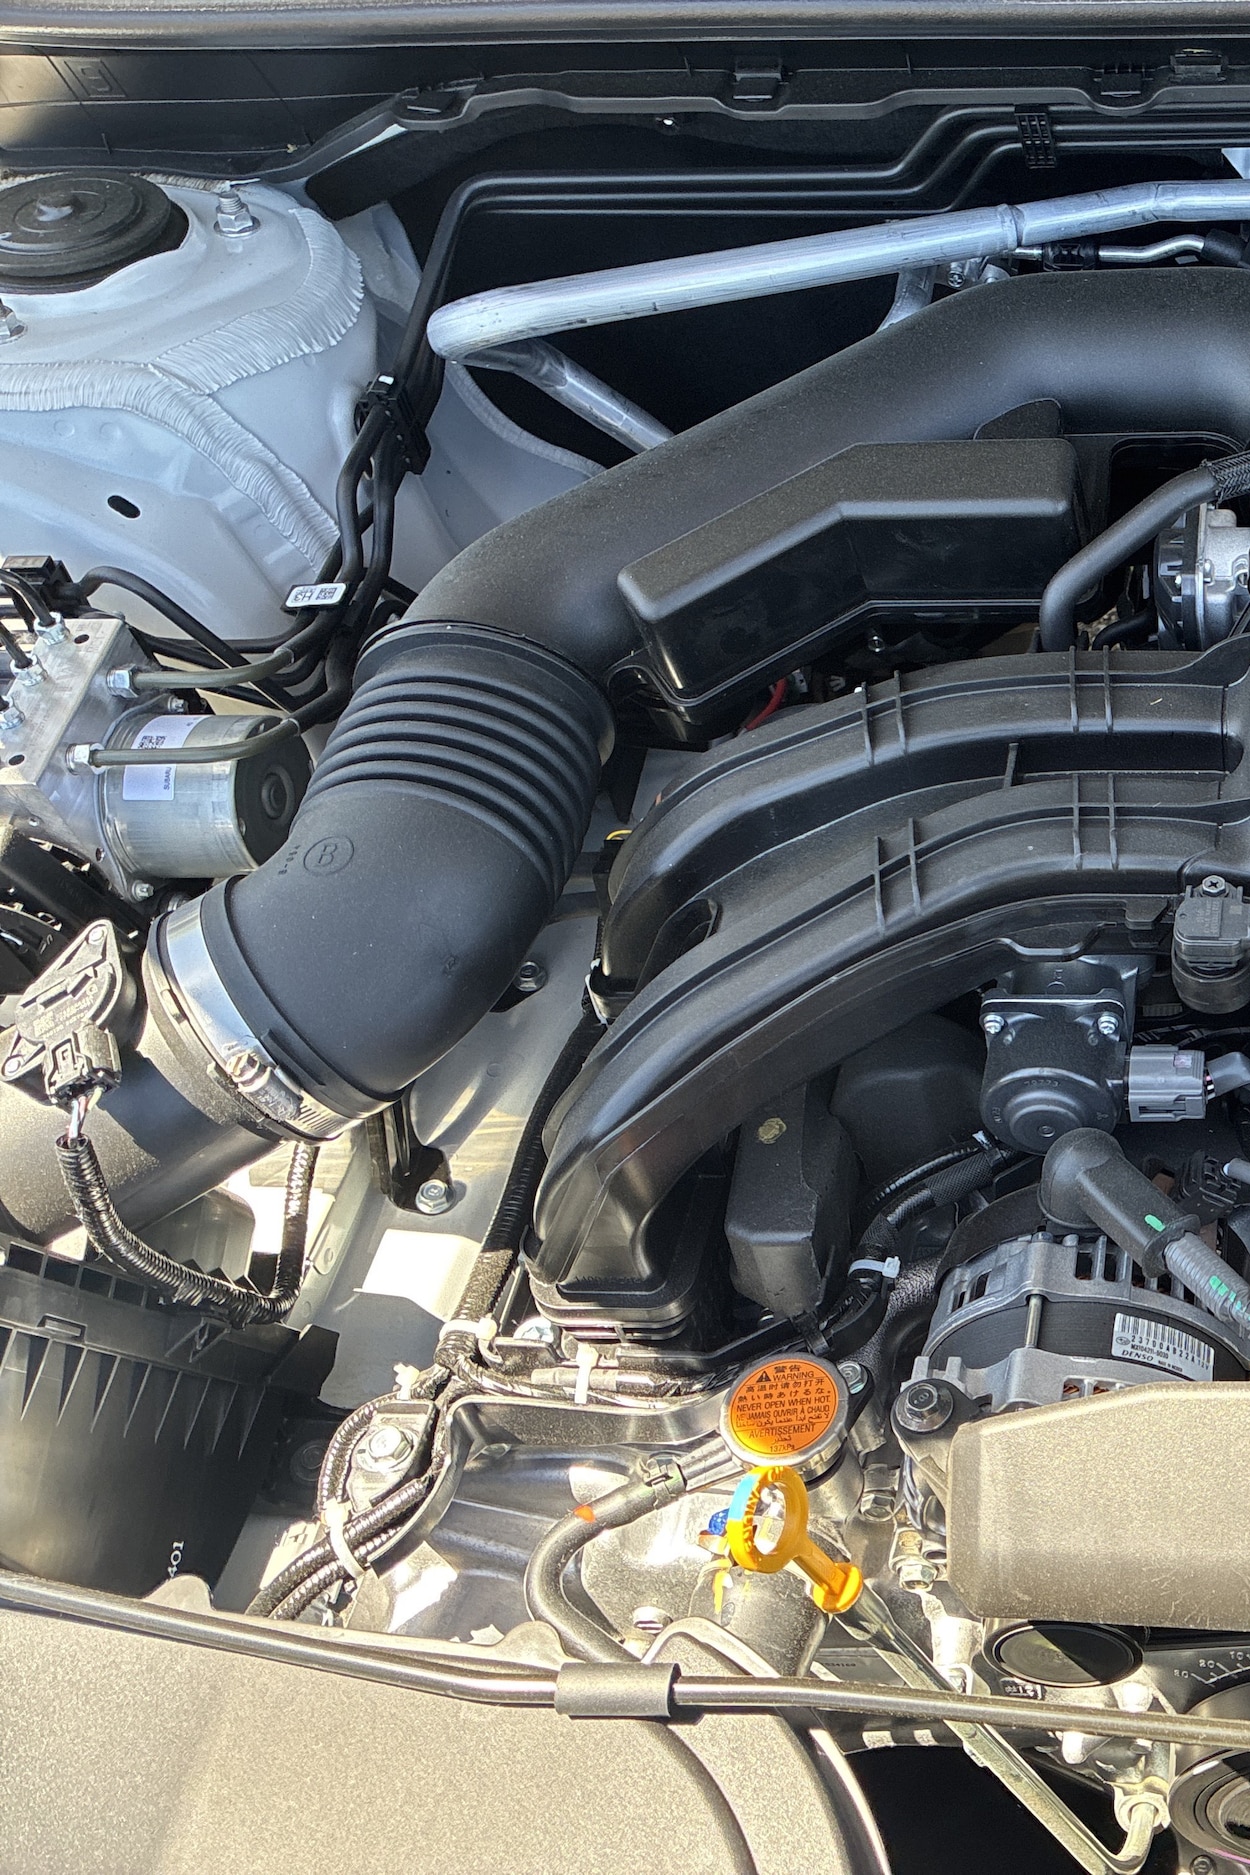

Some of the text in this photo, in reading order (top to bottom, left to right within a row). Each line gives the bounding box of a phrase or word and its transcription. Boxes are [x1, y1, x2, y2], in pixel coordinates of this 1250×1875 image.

[163, 766, 173, 791] SUBARU
[313, 842, 340, 868] B
[1121, 1349, 1154, 1362] DENSO
[774, 1364, 802, 1374] 警告
[773, 1371, 815, 1381] WARNING
[745, 1379, 825, 1393] 高温时请勿打开
[736, 1402, 762, 1413] NEVER
[764, 1399, 785, 1410] OPEN
[788, 1397, 812, 1406] WHEN
[746, 1412, 771, 1421] JAMAIS
[773, 1409, 798, 1418] OUVRIR
[749, 1423, 816, 1439] AVERTISSEMENT
[1229, 1651, 1244, 1661] 10
[1198, 1659, 1215, 1668] 20
